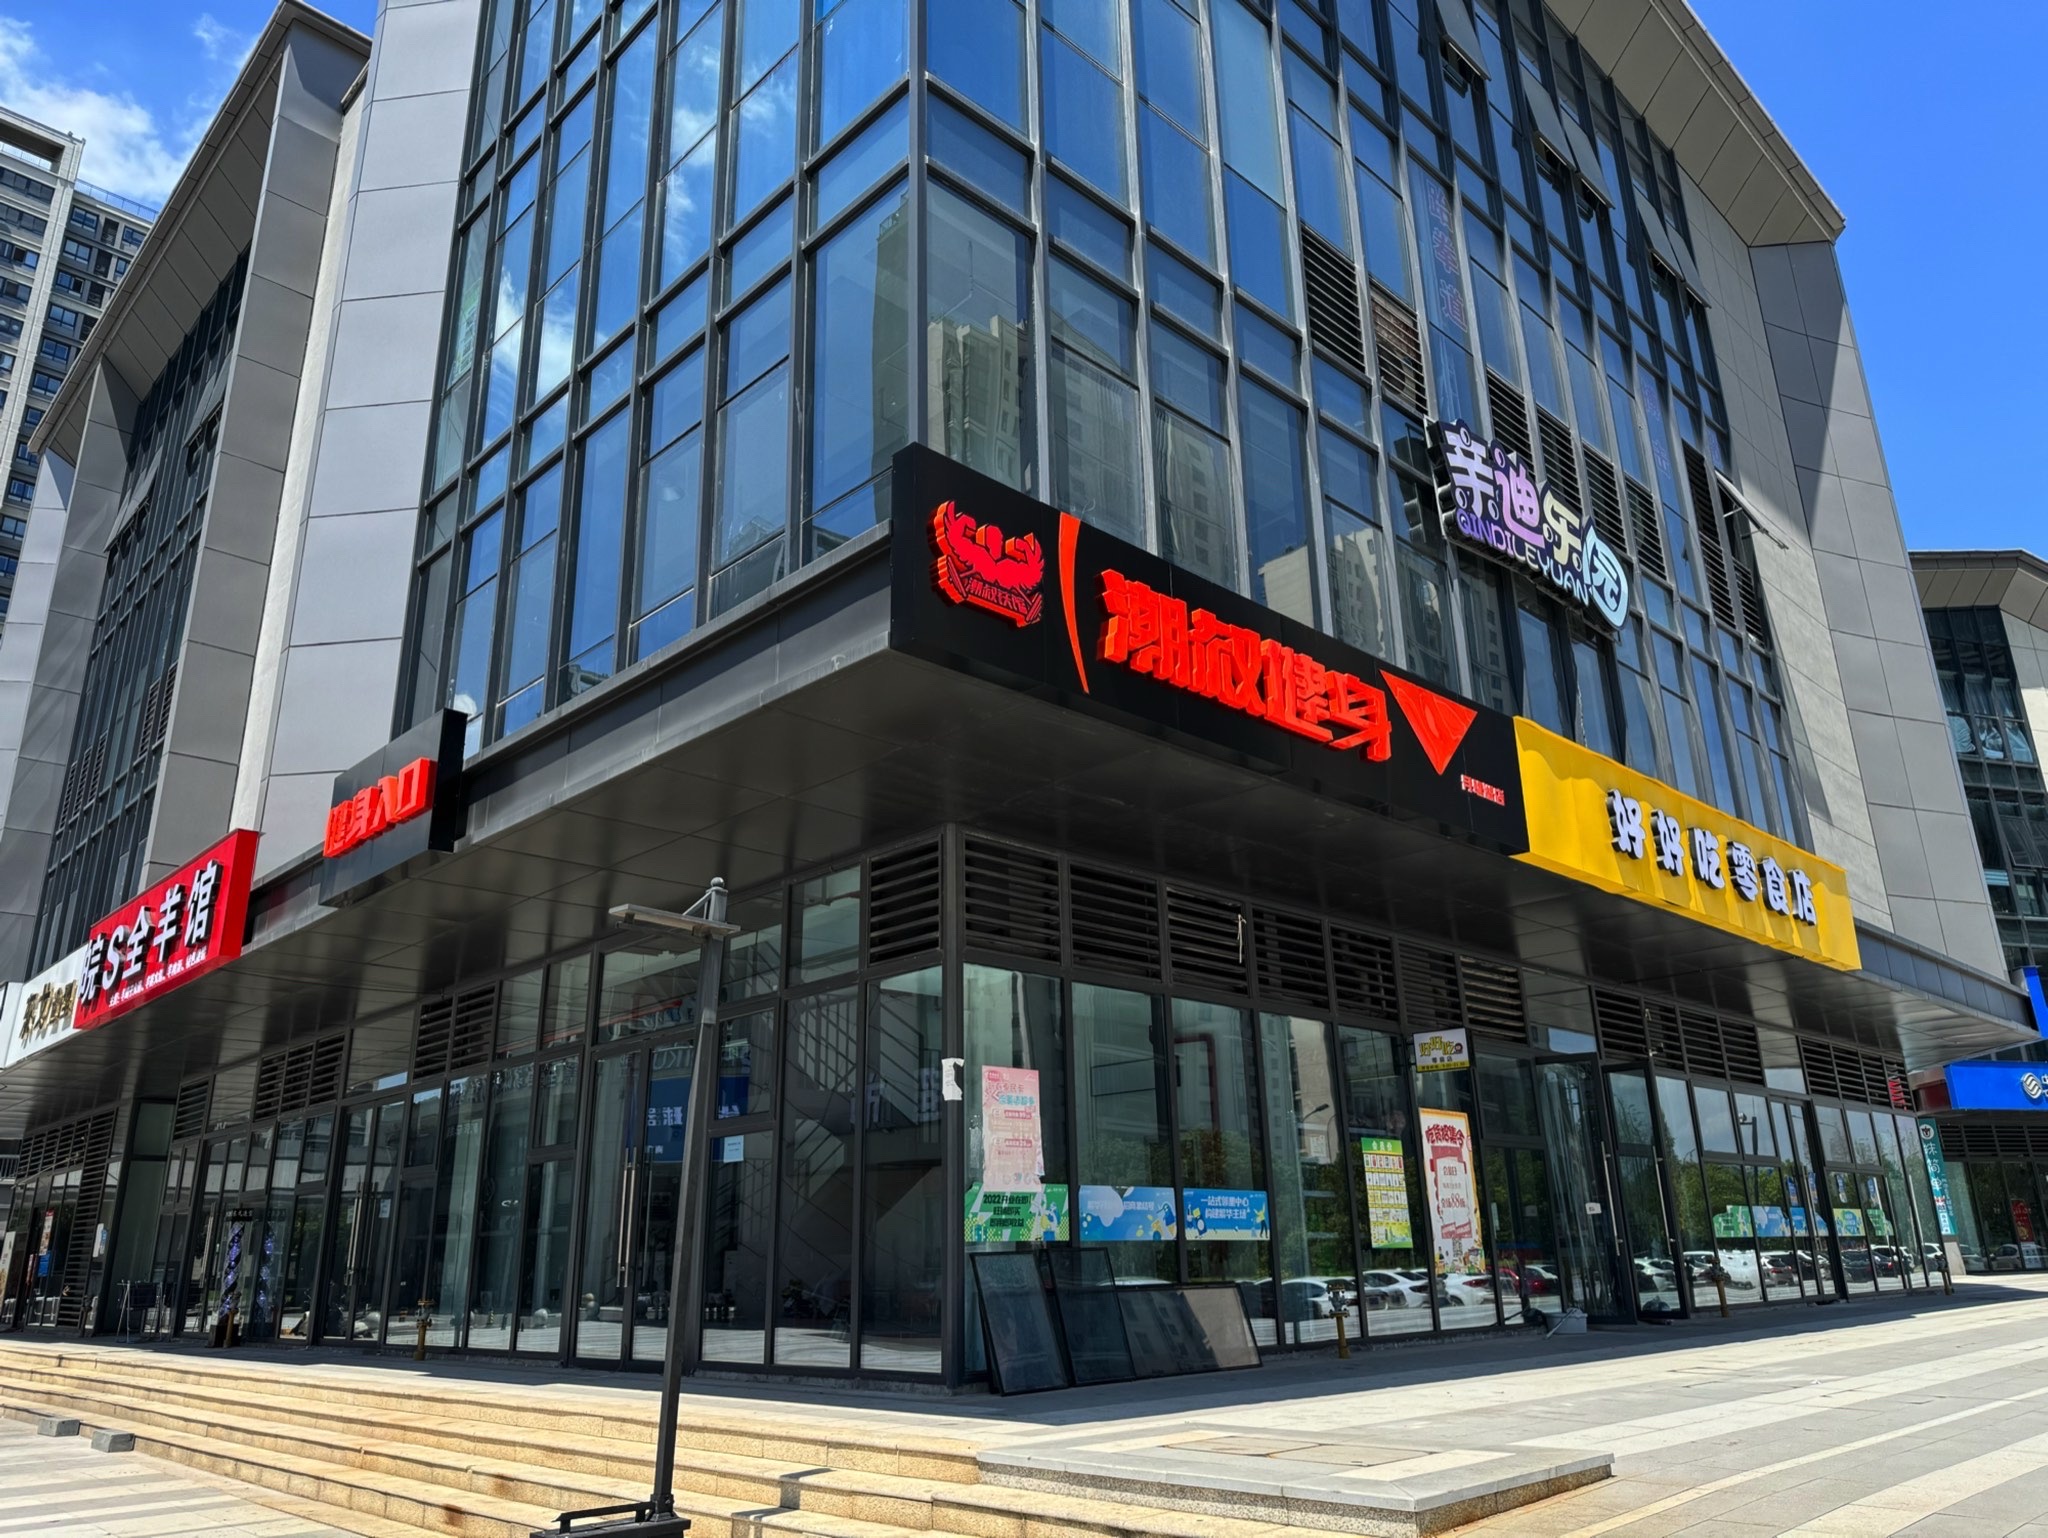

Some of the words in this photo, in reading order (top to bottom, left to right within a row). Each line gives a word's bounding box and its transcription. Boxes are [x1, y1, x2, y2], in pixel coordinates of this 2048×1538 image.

[1426, 178, 1468, 333] 跆拳道
[1444, 427, 1629, 627] 亲迪乐园
[1456, 511, 1590, 606] QINDILEYUAN
[323, 756, 437, 858] 健身入口
[1606, 788, 1817, 926] 好好吃零食店
[78, 858, 223, 1005] 皖S全羊馆
